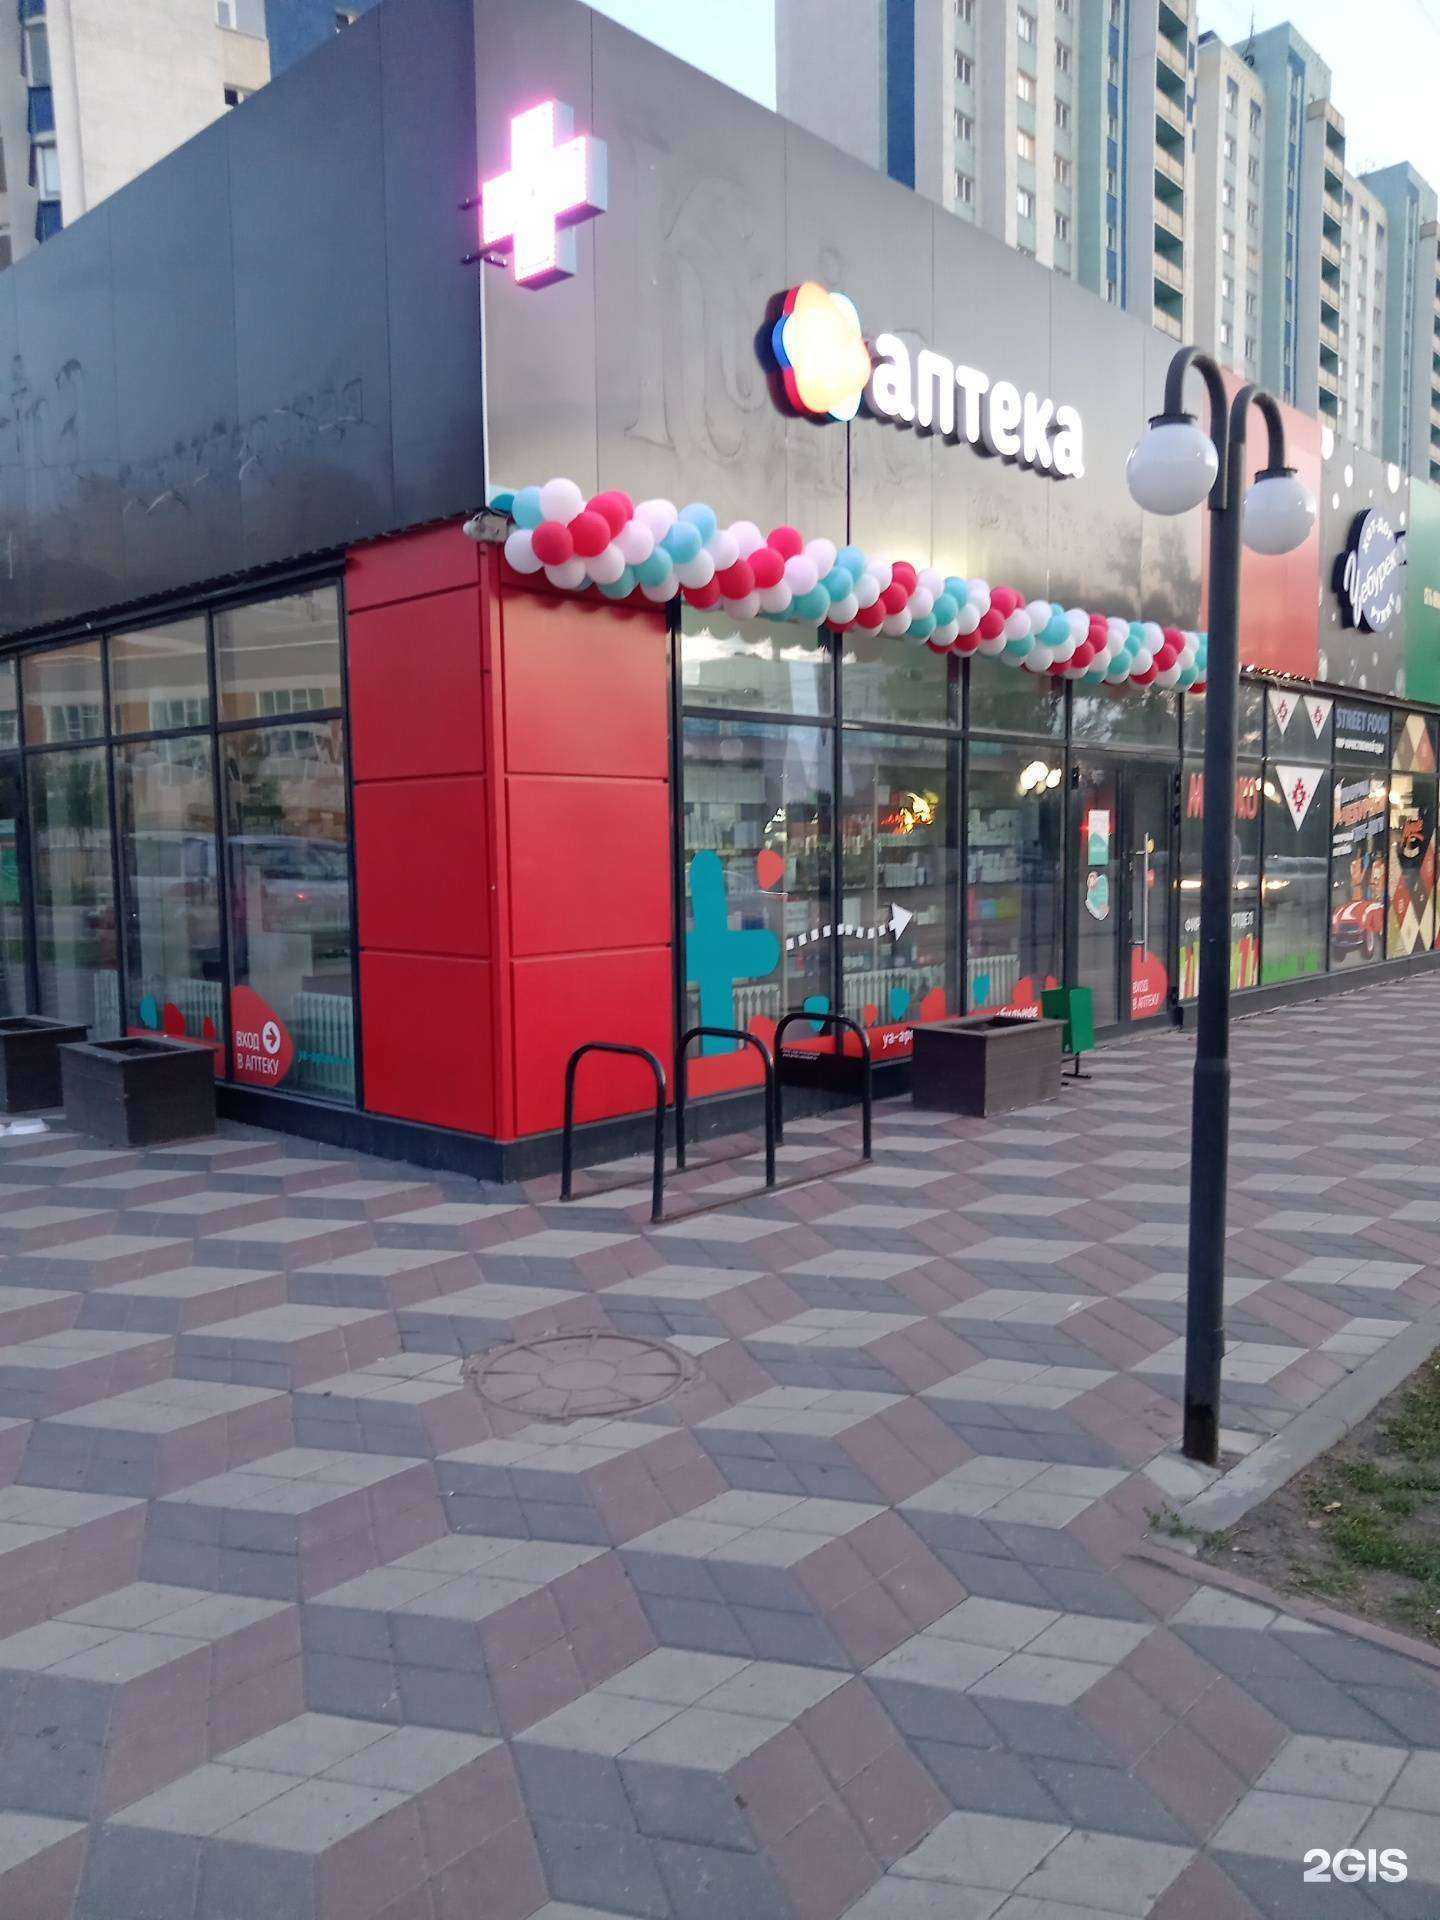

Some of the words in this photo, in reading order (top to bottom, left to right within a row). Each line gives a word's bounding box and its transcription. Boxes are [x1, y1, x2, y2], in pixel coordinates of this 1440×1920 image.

[872, 333, 1085, 479] аптека
[236, 1031, 260, 1051] ВХОД
[237, 1053, 243, 1070] В
[245, 1055, 279, 1075] АПТЕКУ
